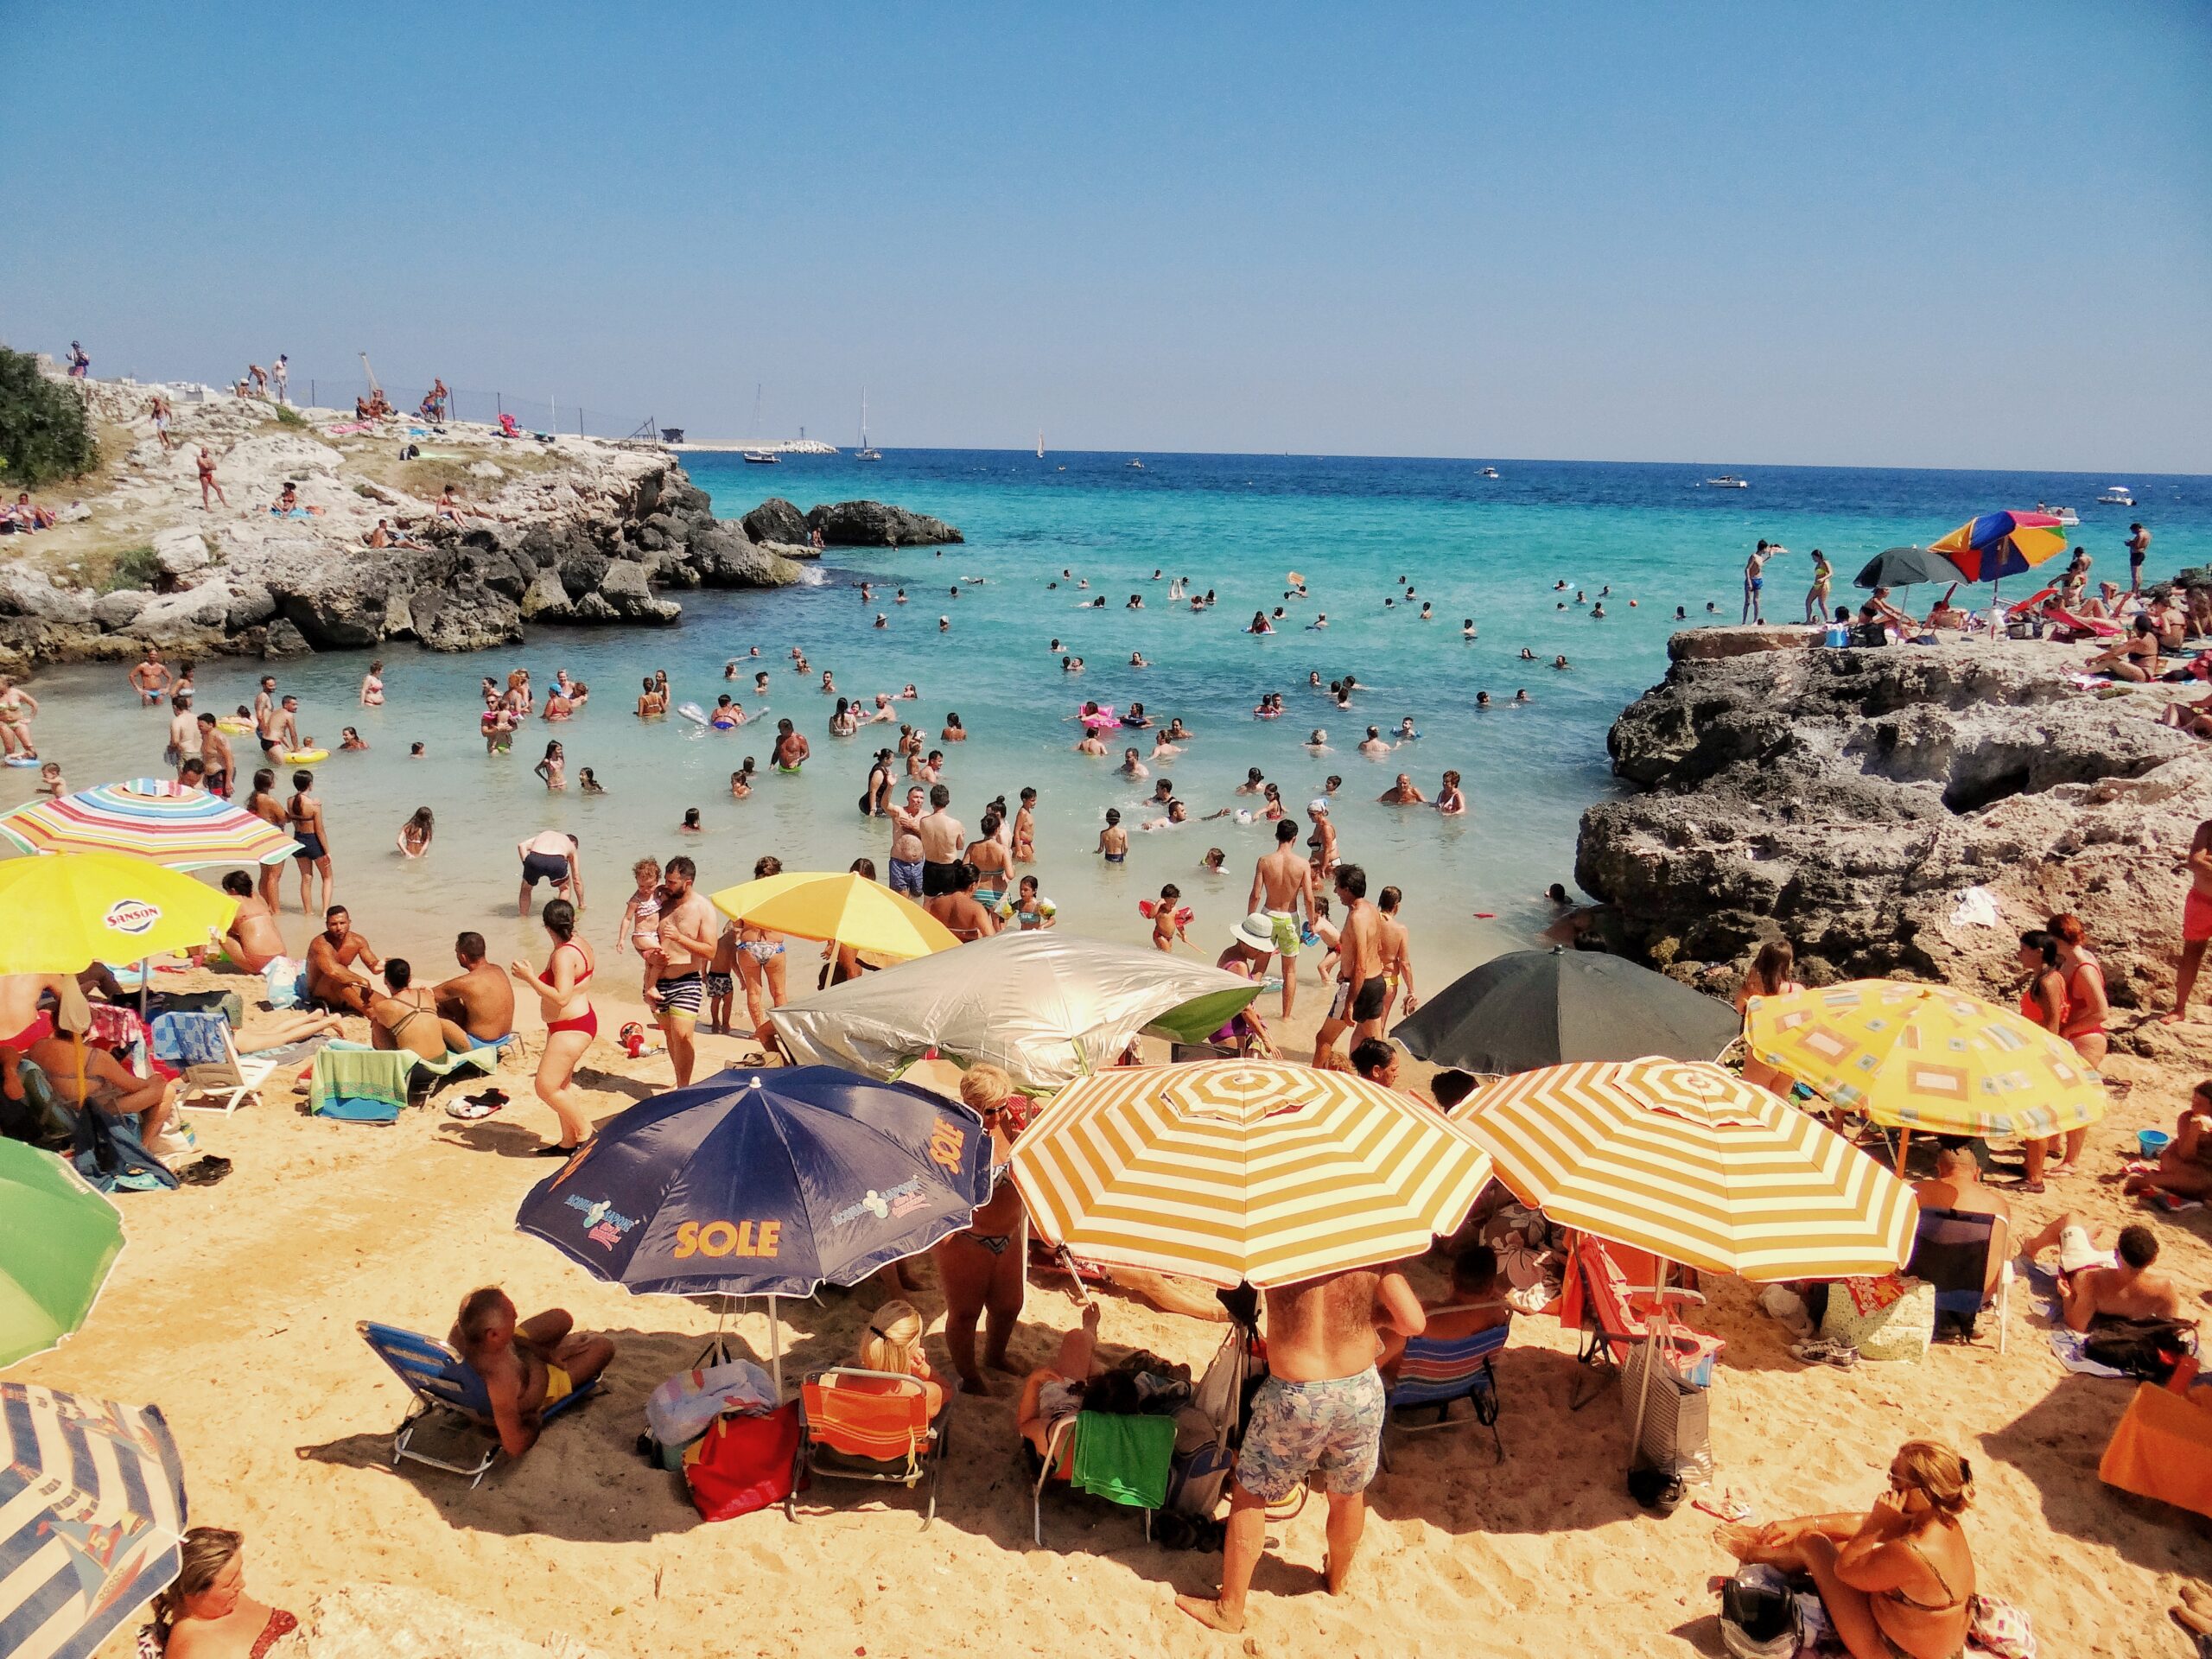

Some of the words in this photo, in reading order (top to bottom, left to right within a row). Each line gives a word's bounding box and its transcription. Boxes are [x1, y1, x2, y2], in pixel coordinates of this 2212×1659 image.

[106, 906, 159, 927] SANSON
[929, 1116, 965, 1175] SOLE
[603, 1210, 635, 1233] SAPONE
[830, 1203, 868, 1227] ACQUA
[880, 1179, 920, 1204] SAPONE
[673, 1219, 782, 1259] SOLE
